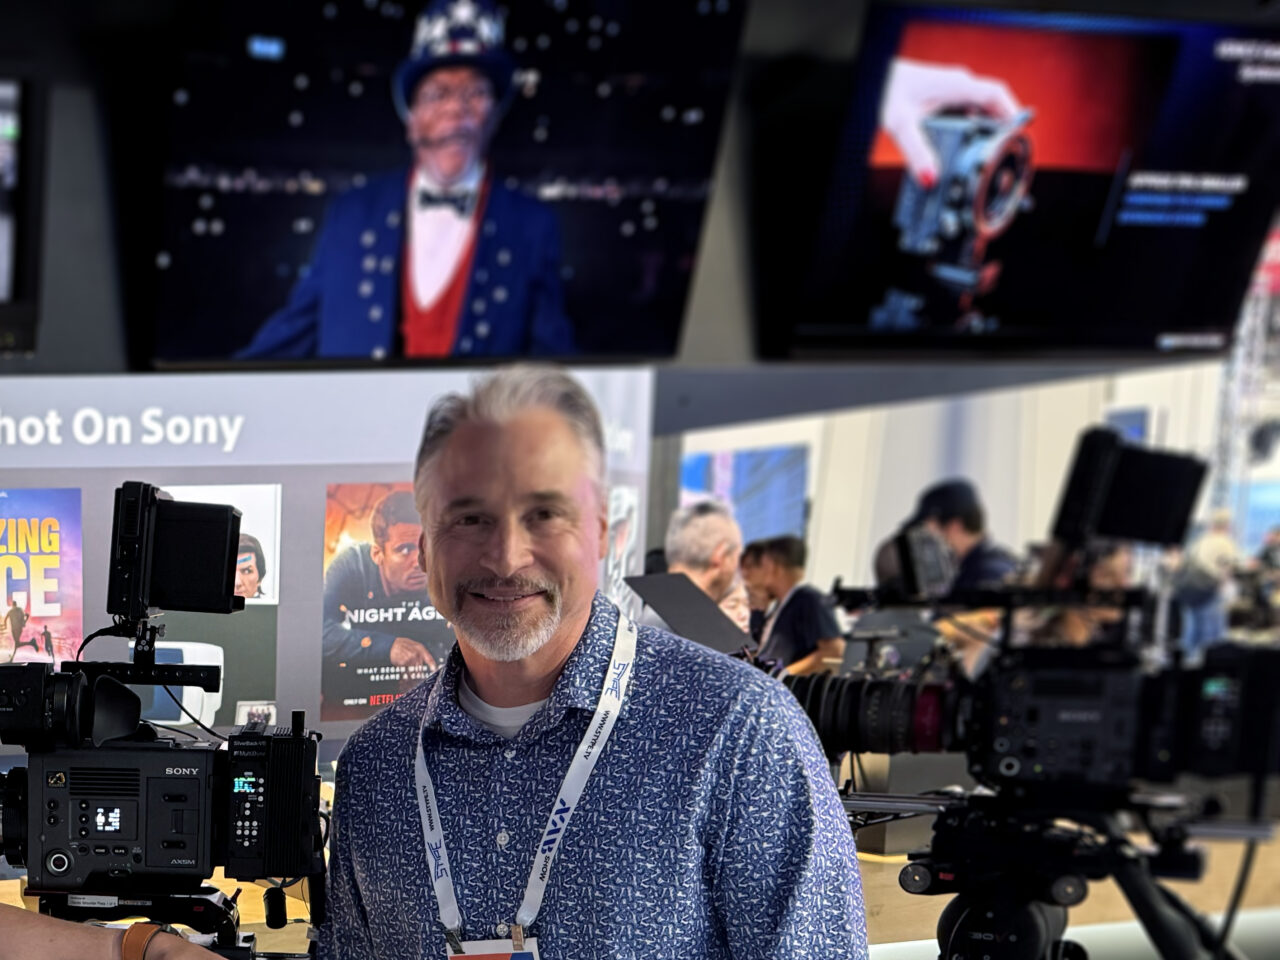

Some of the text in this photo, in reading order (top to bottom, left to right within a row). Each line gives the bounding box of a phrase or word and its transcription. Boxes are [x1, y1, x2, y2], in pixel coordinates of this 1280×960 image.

[72, 407, 131, 446] On
[141, 407, 245, 453] Sony
[341, 606, 446, 630] NIGHT AG
[584, 710, 610, 760] WWW.STYPE.TV
[165, 767, 199, 775] SONY
[539, 855, 551, 882] SHOW
